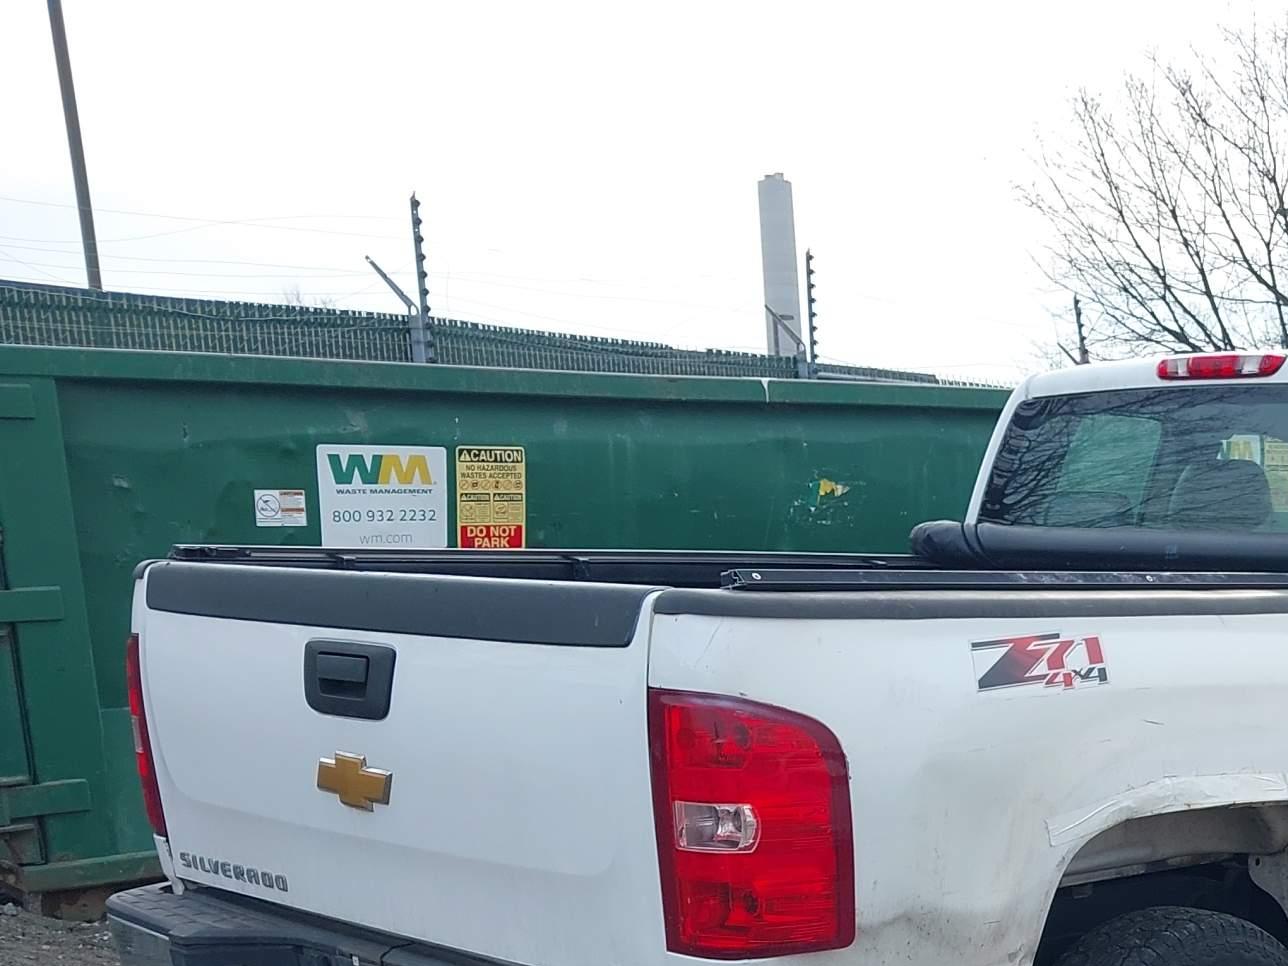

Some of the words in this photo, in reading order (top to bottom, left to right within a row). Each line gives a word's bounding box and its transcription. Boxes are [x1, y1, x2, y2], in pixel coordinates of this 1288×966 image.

[470, 449, 521, 462] CAUTION
[327, 454, 433, 485] WM
[465, 464, 475, 472] NO
[476, 464, 517, 472] HAZARDOUS
[332, 510, 362, 523] 800
[366, 509, 395, 522] 932
[399, 509, 437, 522] 2232
[466, 526, 487, 538] DO
[489, 525, 517, 538] NOT
[359, 533, 413, 545] wm.com
[474, 537, 510, 548] PARK
[179, 851, 289, 893] SILVERADO
